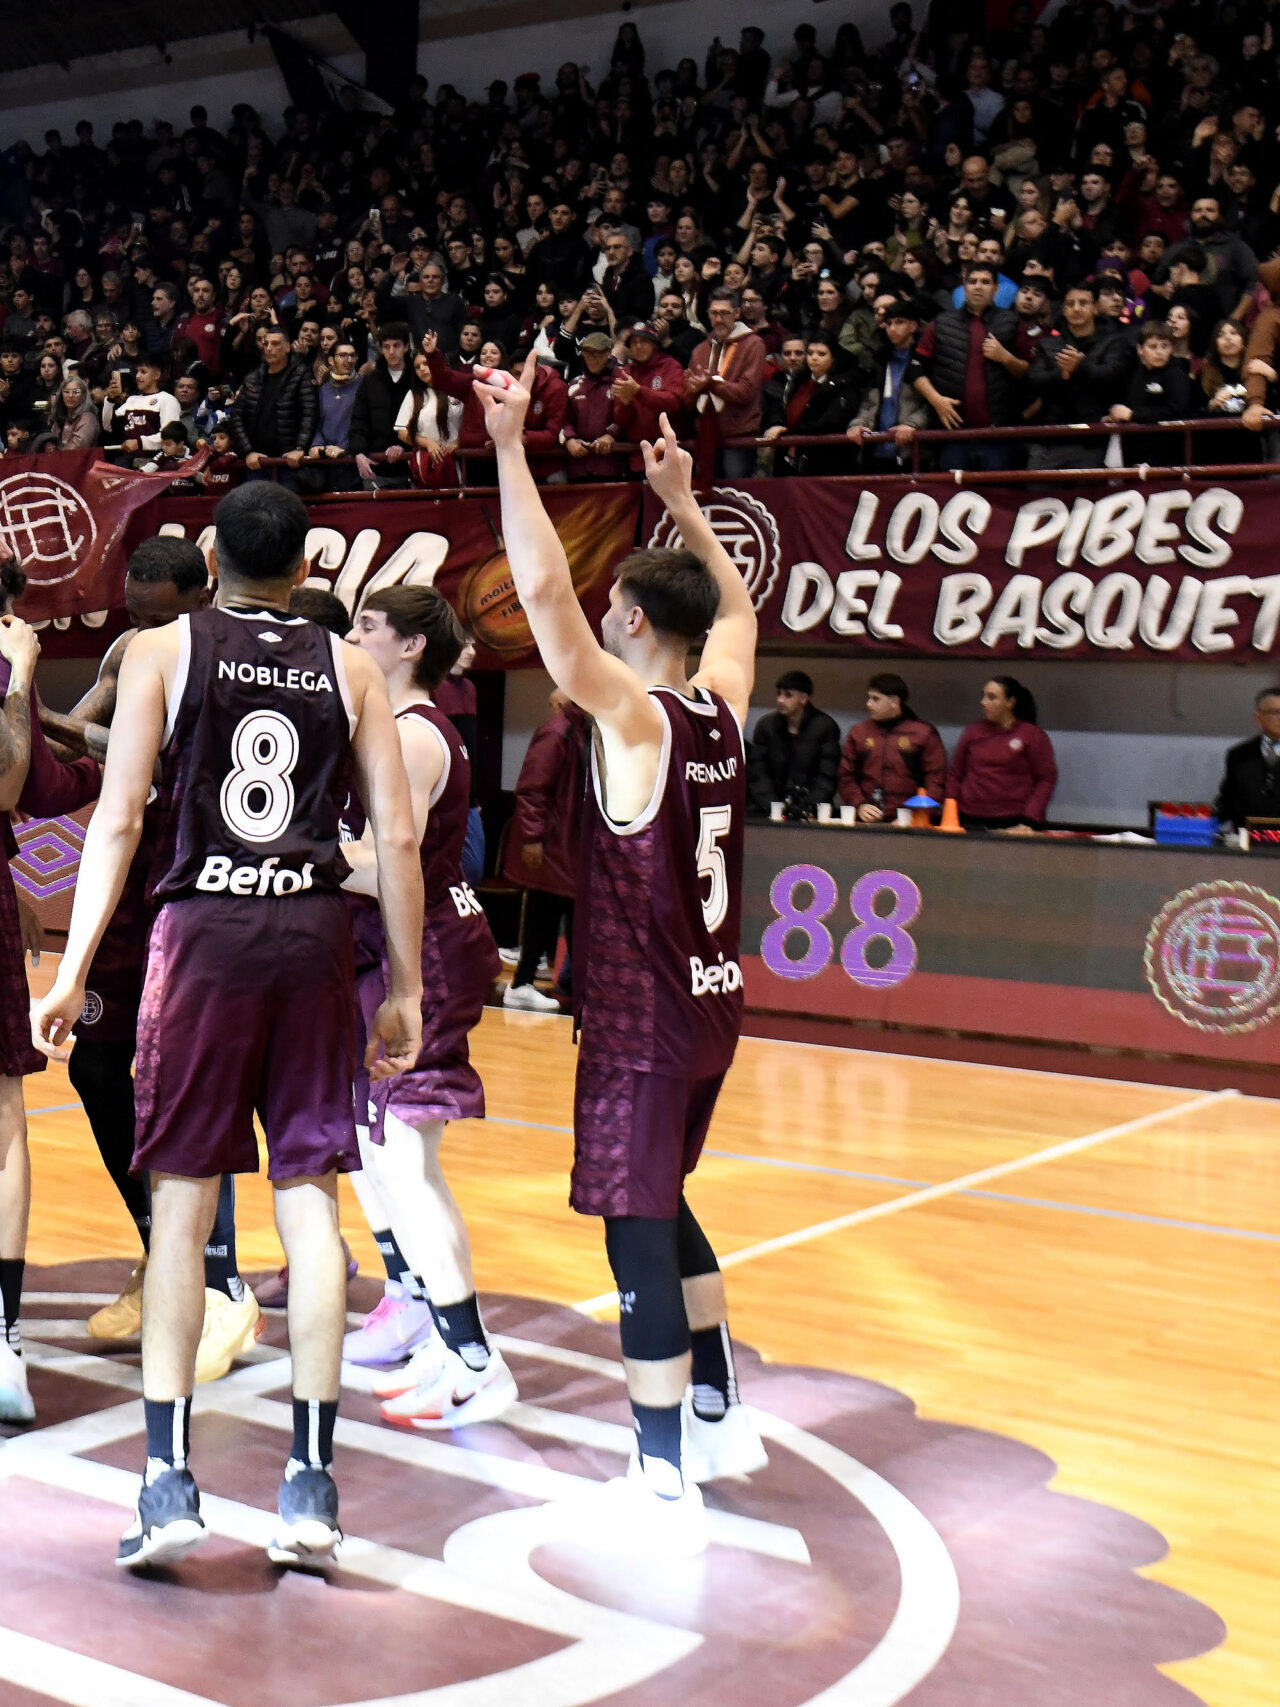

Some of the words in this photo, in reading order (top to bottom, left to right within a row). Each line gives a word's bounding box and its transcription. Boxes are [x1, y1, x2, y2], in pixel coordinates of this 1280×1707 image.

[845, 490, 992, 565] LOS
[1005, 487, 1243, 568] PIBES
[781, 561, 904, 641] DEL
[933, 571, 1280, 653] BASQUET
[218, 660, 334, 692] NOBLEGA
[220, 709, 300, 843] 8
[195, 855, 314, 896] Befol
[695, 804, 732, 933] 5
[760, 863, 922, 989] 88
